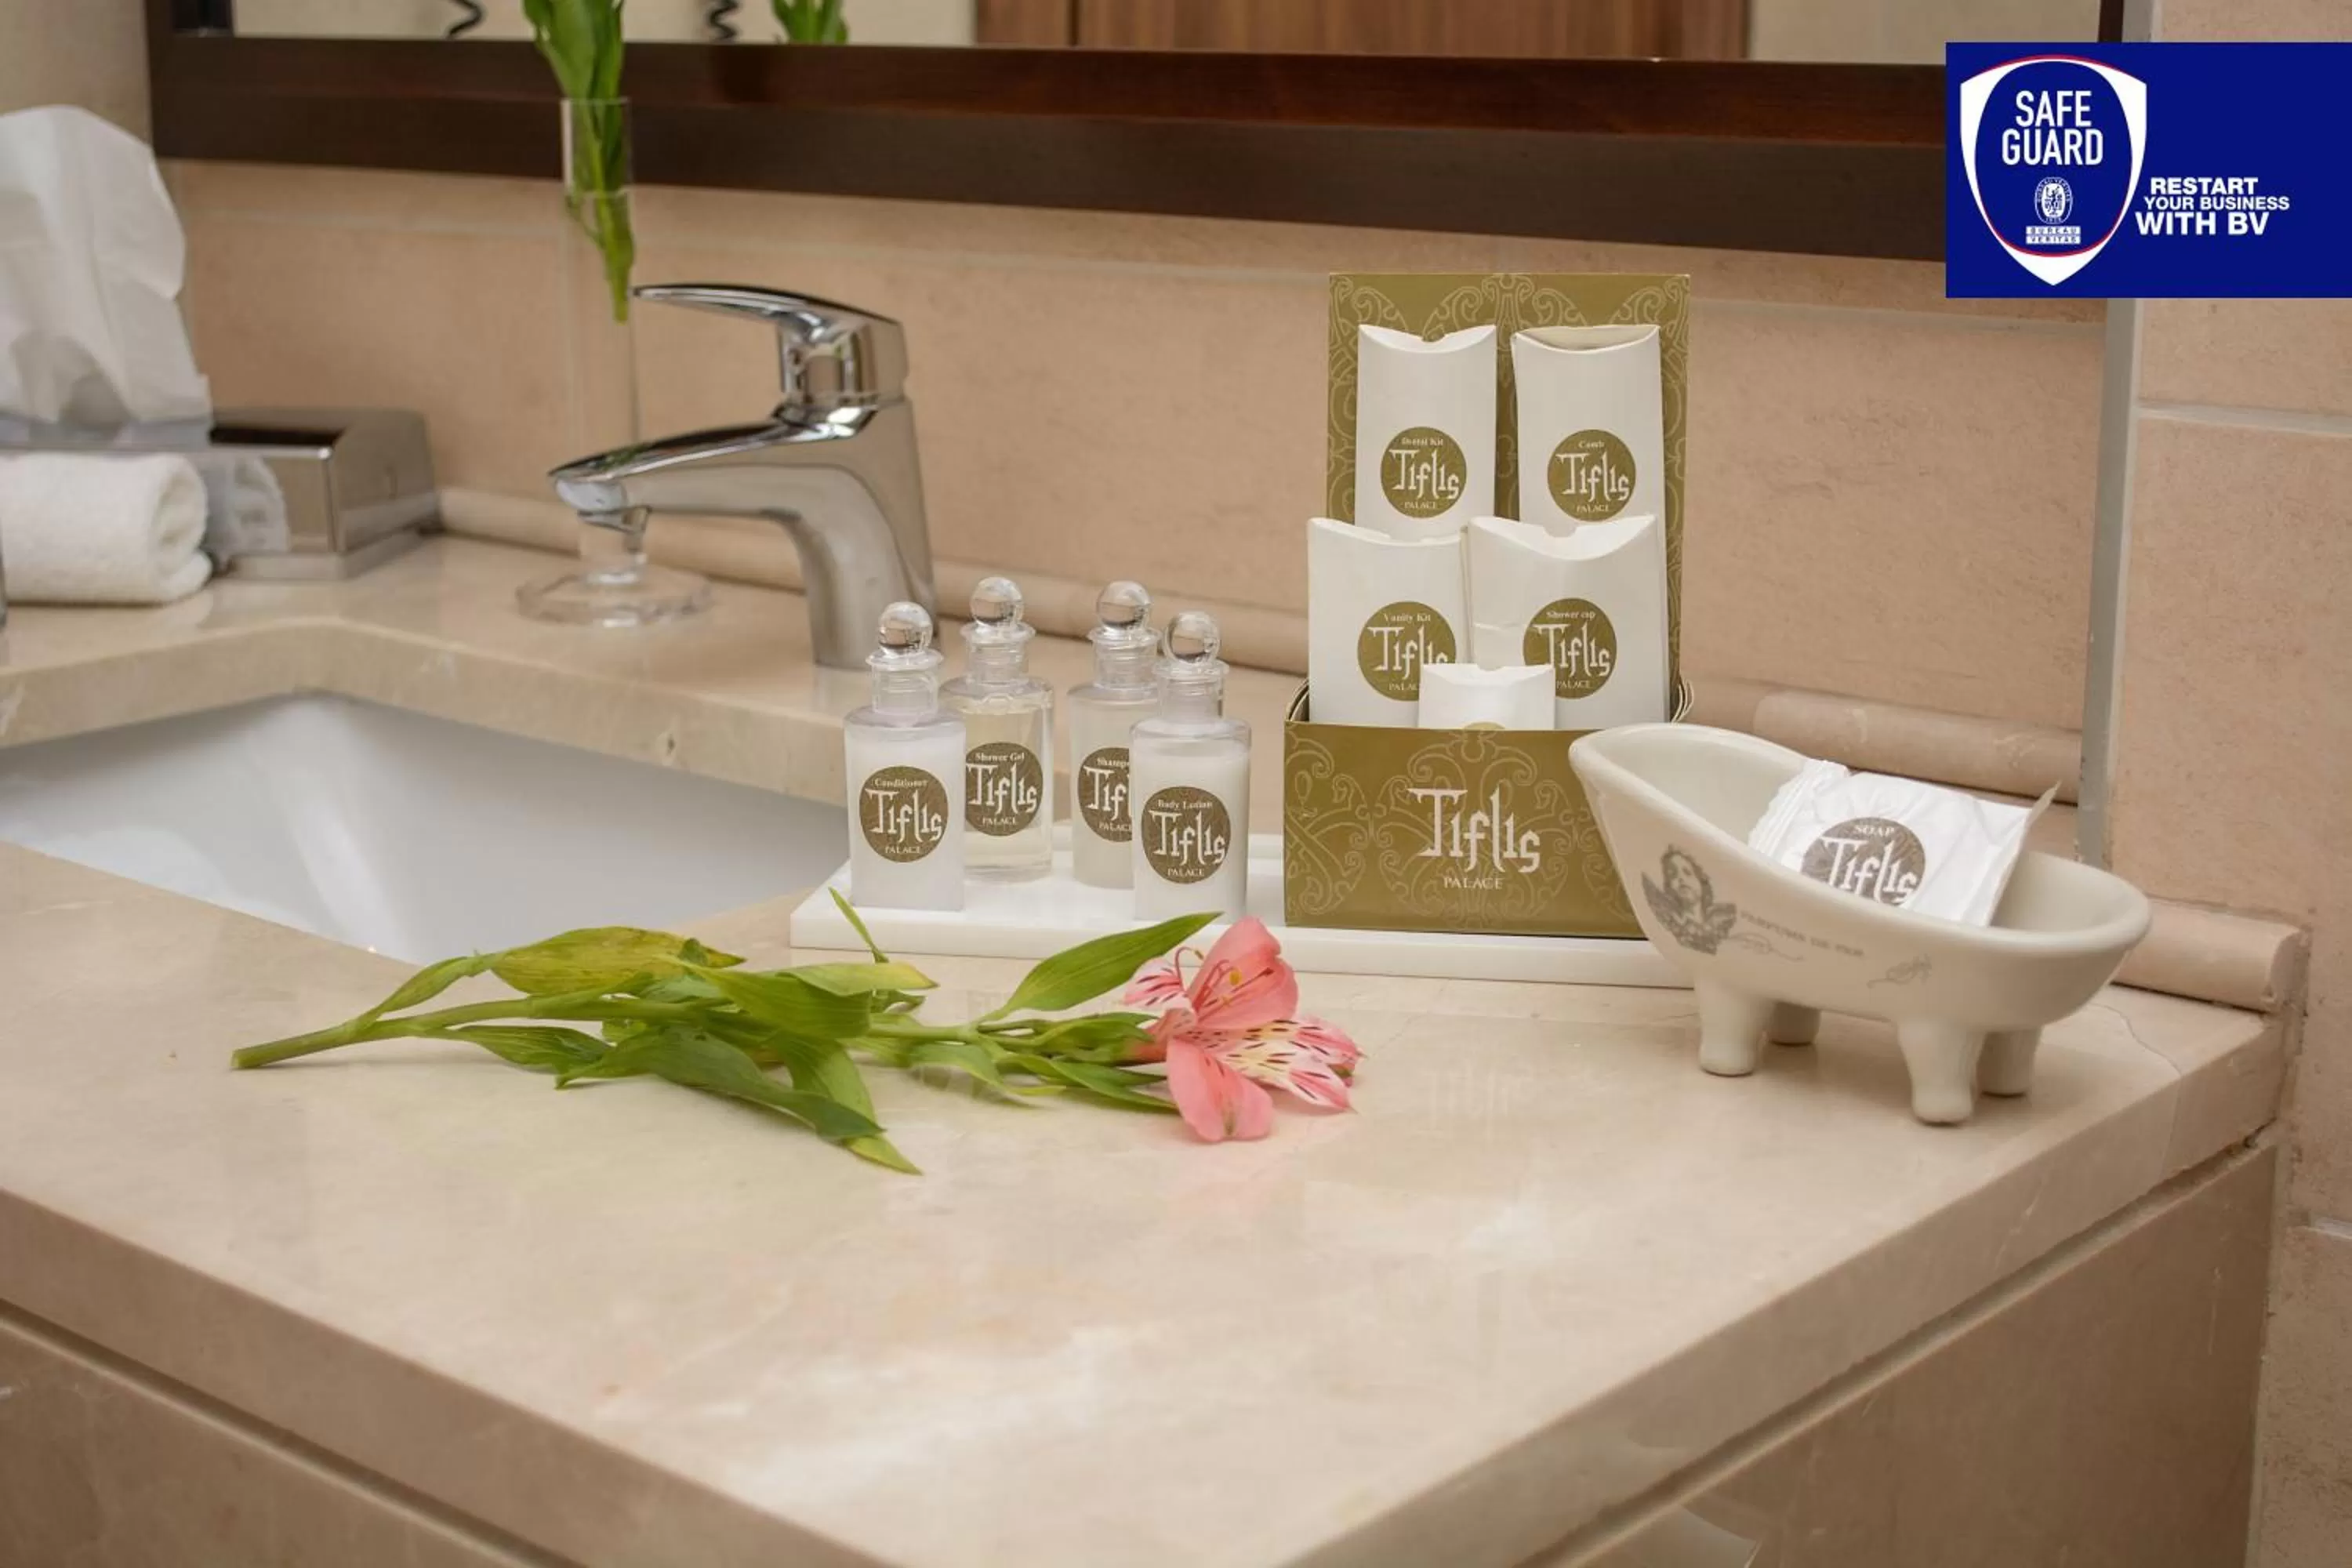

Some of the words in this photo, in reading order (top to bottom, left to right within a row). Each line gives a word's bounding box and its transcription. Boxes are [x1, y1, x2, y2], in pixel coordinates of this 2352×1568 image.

[1388, 448, 1460, 499] Tiflis
[1555, 452, 1630, 502] Tiflis
[1404, 501, 1436, 510] PALACE
[1577, 504, 1610, 514] PALACE
[1417, 612, 1431, 622] Kit
[1533, 622, 1611, 677] Tiflis
[1556, 681, 1592, 689] PALACE
[966, 762, 1037, 815] Tiflis
[865, 789, 942, 844] Tiflis
[982, 817, 1018, 826] PALACE
[1408, 786, 1541, 873] Tiflis
[1853, 824, 1896, 837] SOAP
[1149, 810, 1225, 866] Tiflis
[1167, 868, 1205, 877] PALACE
[1443, 877, 1504, 889] PALACE
[1820, 837, 1918, 903] Tiflis
